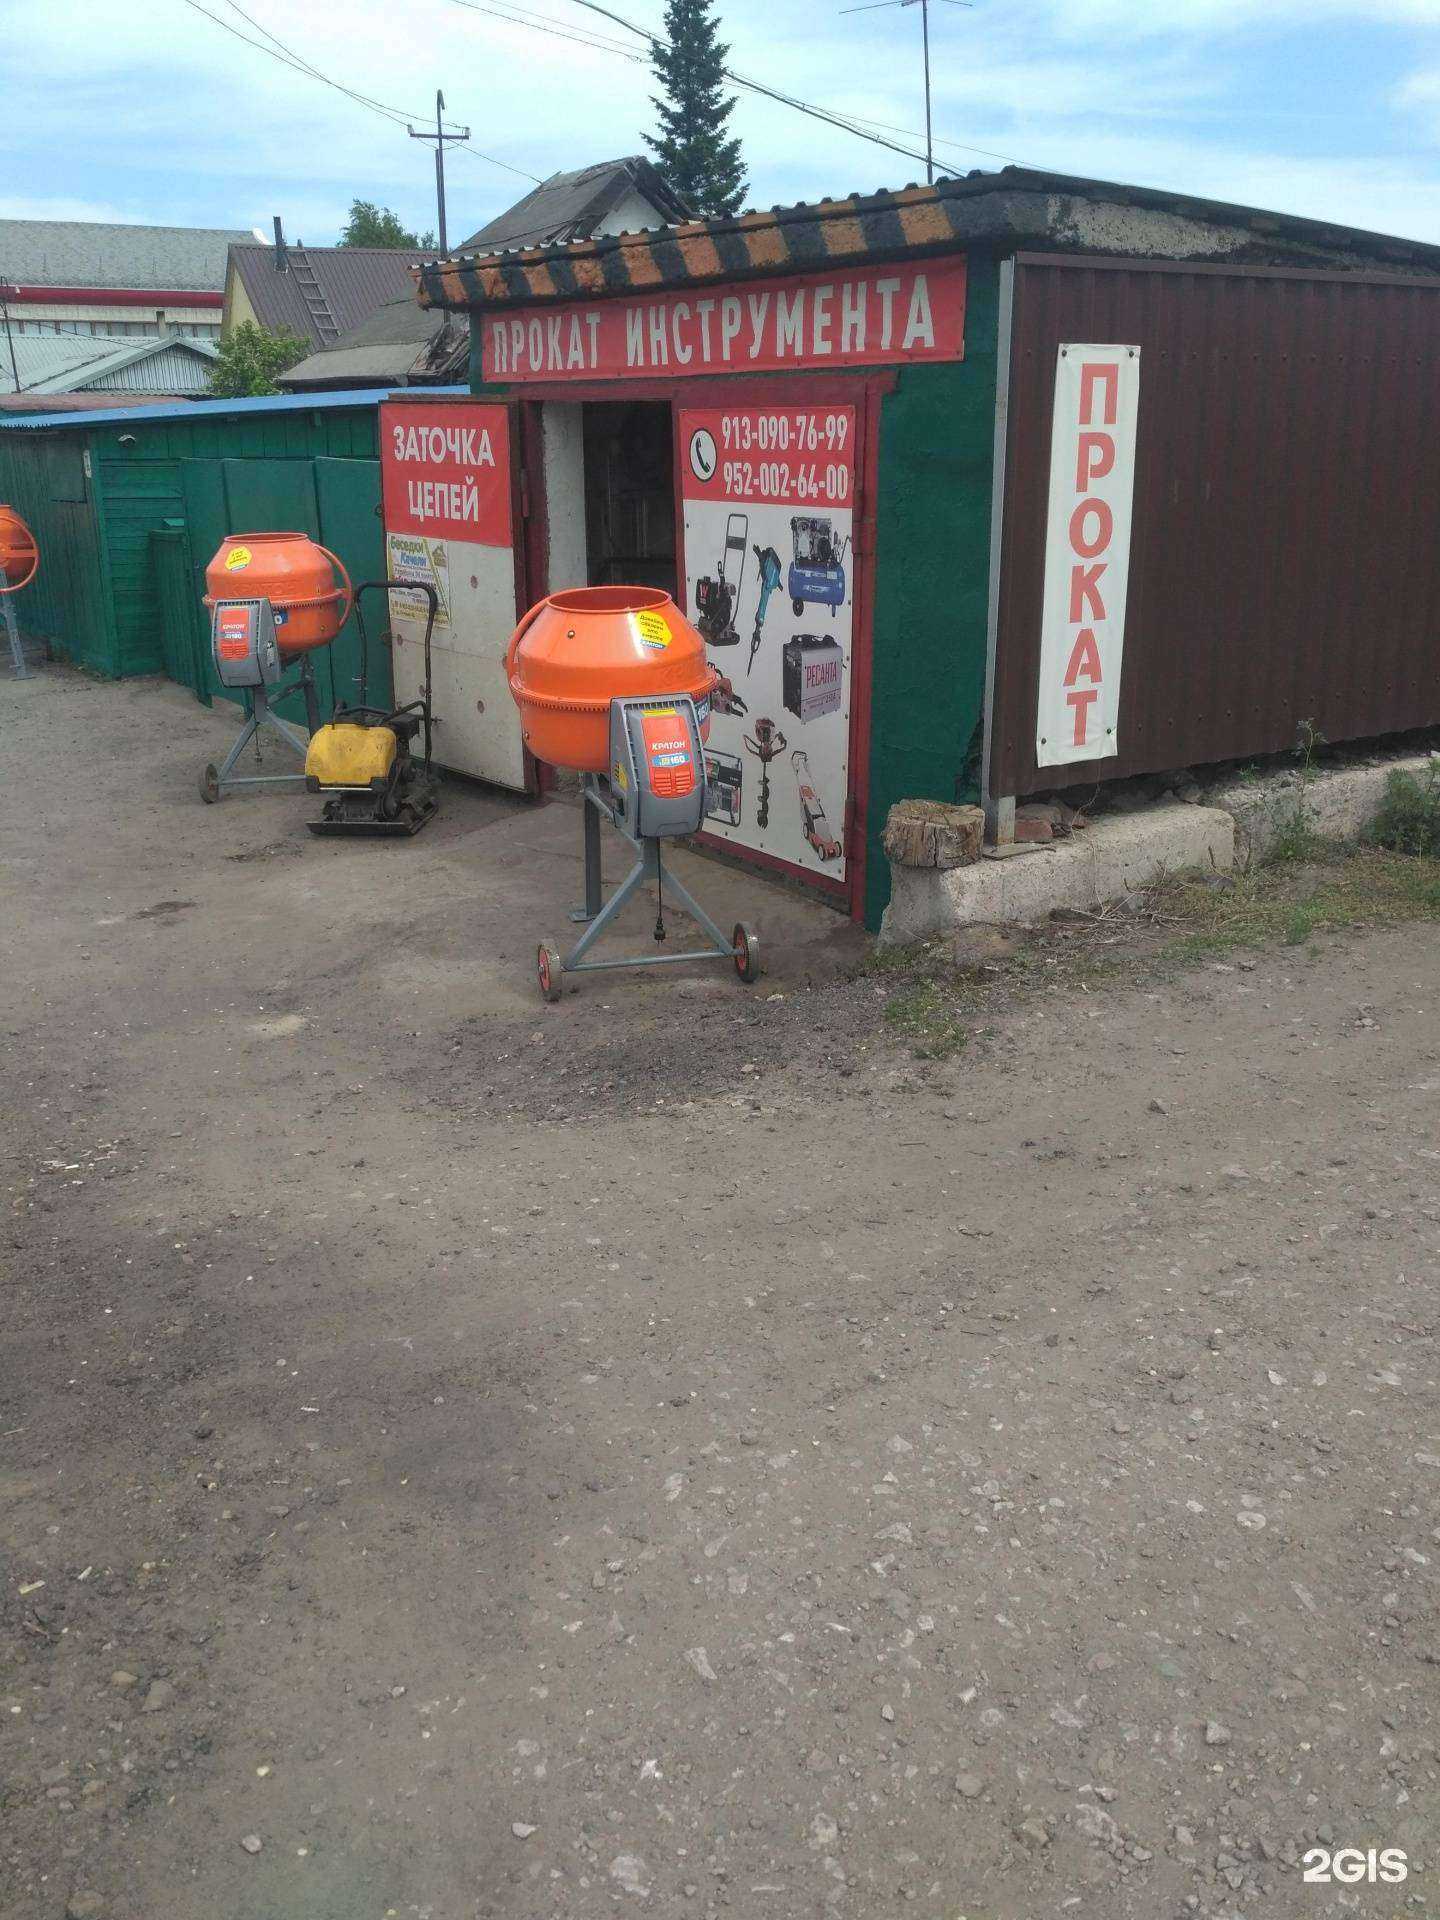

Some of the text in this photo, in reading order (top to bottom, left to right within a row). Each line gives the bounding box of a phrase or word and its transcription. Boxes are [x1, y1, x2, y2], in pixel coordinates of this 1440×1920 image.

[493, 274, 935, 373] ПРОКАТ ИНСТРУМЕНТА
[393, 425, 496, 467] ЗАТОЧКА
[722, 415, 848, 450] 913-090-76-99
[408, 475, 479, 522] ЦЕПЕЙ
[723, 462, 848, 499] 952-002-64-00
[1063, 363, 1120, 747] ПРОКАТ
[807, 661, 837, 688] РЕСАНТА
[652, 740, 686, 751] КРАТОН
